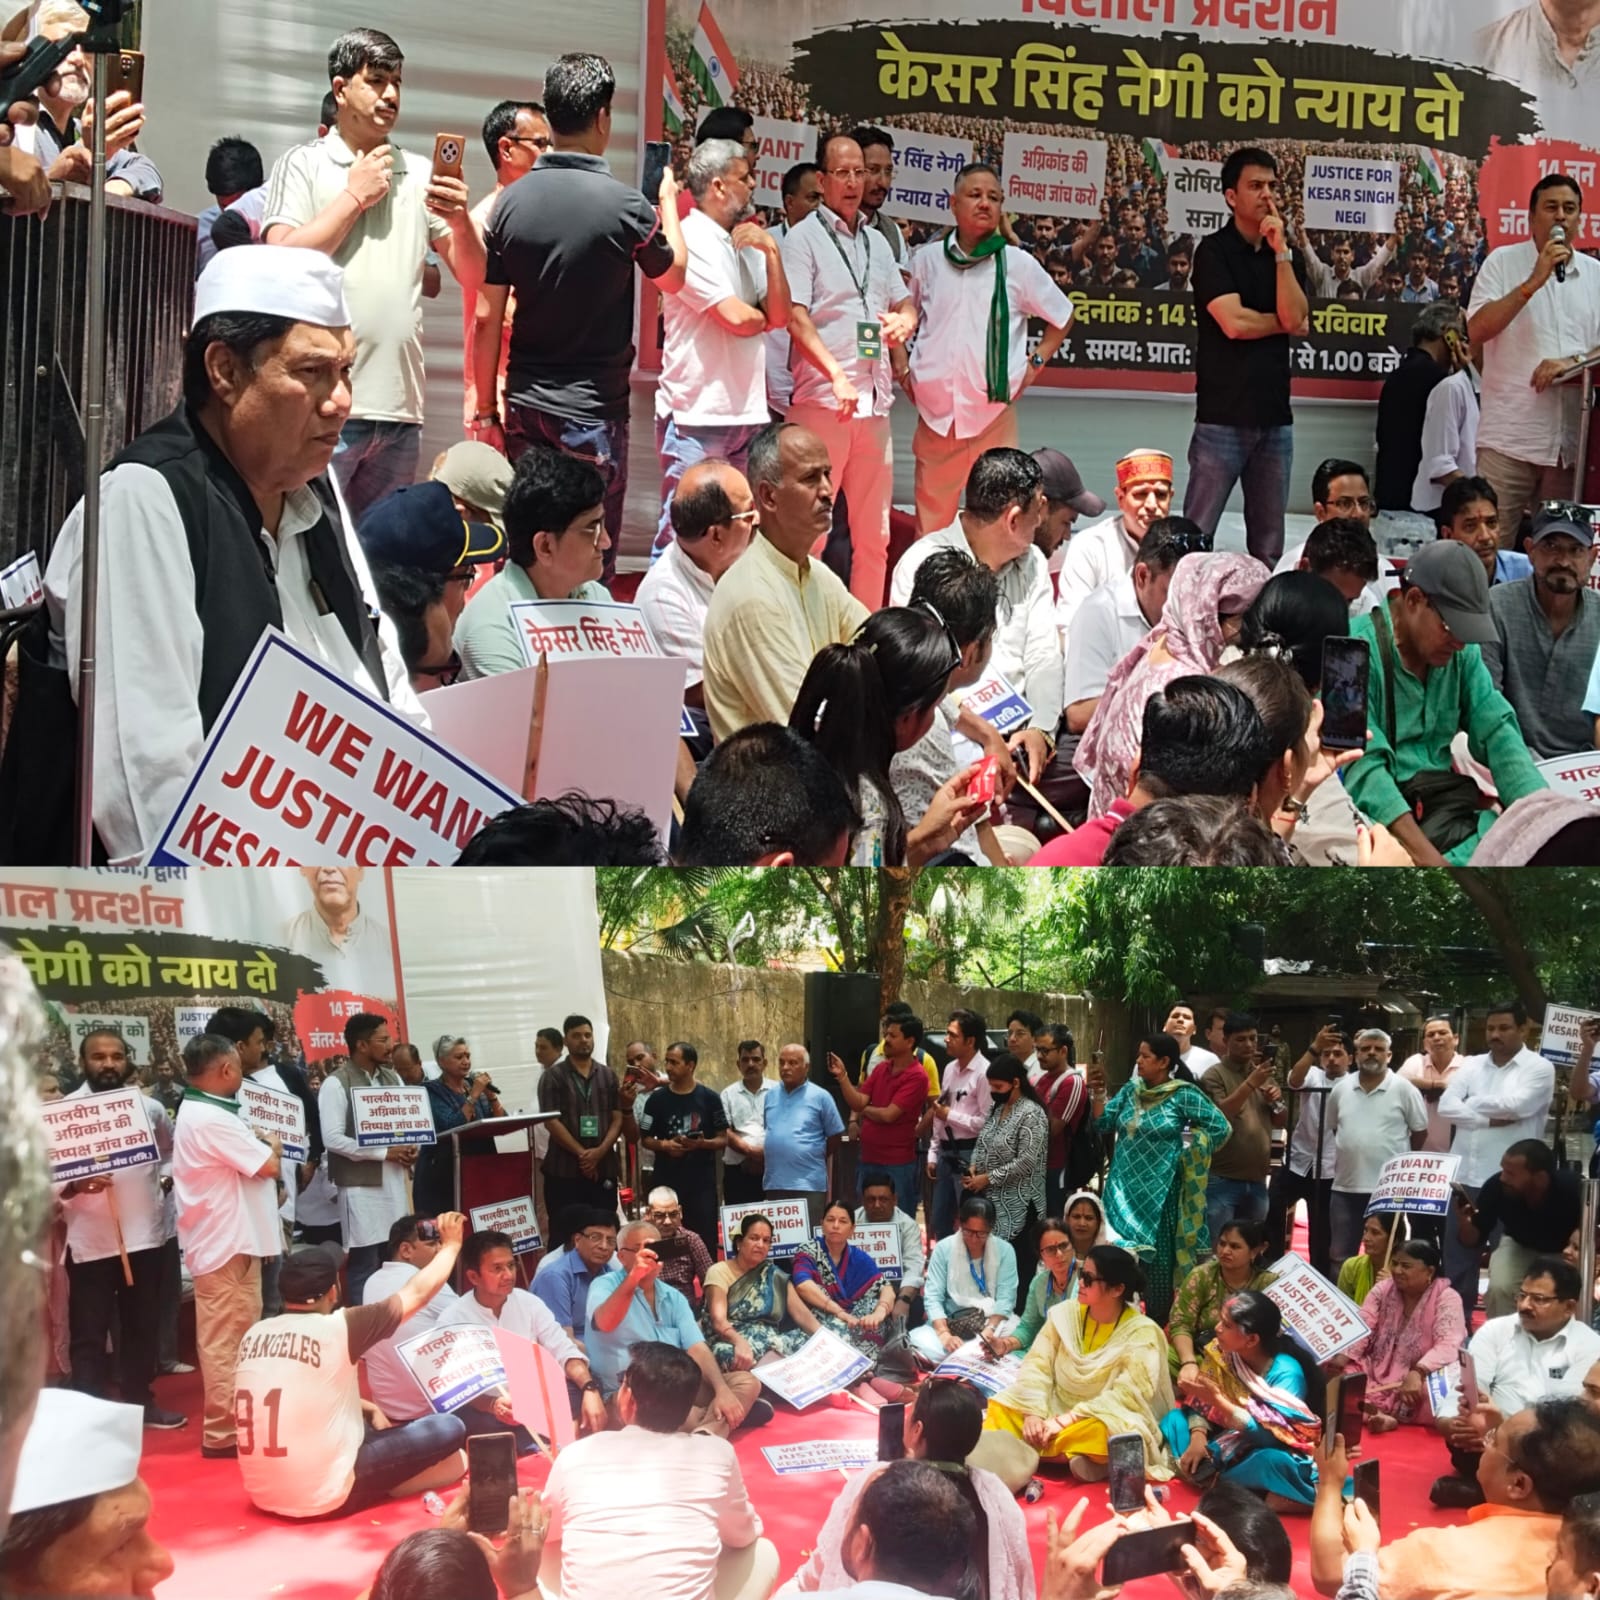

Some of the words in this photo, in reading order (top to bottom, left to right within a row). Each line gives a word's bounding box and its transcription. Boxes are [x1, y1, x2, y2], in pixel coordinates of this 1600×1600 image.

[876, 31, 1003, 106] केसर
[1010, 42, 1109, 121] सिंह
[1116, 49, 1209, 119] नेगी
[1216, 58, 1286, 124] को
[1293, 78, 1406, 133] न्याय
[1413, 72, 1465, 141] दो
[904, 146, 934, 172] सिंह
[936, 150, 966, 173] नेगी
[1070, 149, 1088, 174] की
[1311, 164, 1364, 182] JUSTICE
[1366, 168, 1393, 183] FOR
[896, 187, 933, 207] न्याय
[935, 188, 951, 211] दो
[1009, 176, 1047, 201] निष्पक्ष
[1049, 180, 1073, 204] जांच
[1074, 182, 1098, 208] करो
[1307, 186, 1351, 201] KESAR
[1353, 189, 1396, 205] SINGH
[1186, 208, 1224, 230] सजा
[1335, 210, 1367, 225] NEGI
[1067, 291, 1142, 325] दिनांक
[1158, 303, 1186, 327] 14
[1312, 303, 1388, 336] रविवार
[1296, 341, 1317, 370] से
[1319, 349, 1364, 372] 1.00
[1367, 344, 1402, 374] बजे
[523, 618, 583, 654] केसर
[579, 615, 622, 656] सिंह
[614, 618, 653, 654] नेगी
[973, 679, 1006, 703] करो
[283, 690, 373, 779] WE
[372, 747, 497, 851] WAN
[220, 744, 417, 866] JUSTICE
[64, 884, 185, 929] प्रदर्शन
[99, 943, 152, 987] को
[157, 956, 238, 990] न्याय
[243, 950, 278, 994] दो
[329, 1001, 344, 1017] 14
[126, 1021, 145, 1037] को
[1548, 1024, 1579, 1038] KESAR
[104, 1098, 135, 1113] नगर
[243, 1088, 279, 1108] मालवीय
[281, 1100, 300, 1114] नगर
[361, 1091, 400, 1104] मालवीय
[403, 1094, 422, 1103] नगर
[408, 1104, 420, 1115] की
[114, 1114, 132, 1129] की
[285, 1114, 297, 1128] की
[414, 1118, 431, 1129] करो
[93, 1137, 122, 1153] जांच
[124, 1129, 149, 1147] करो
[1400, 1158, 1445, 1170] WANT
[1418, 1173, 1448, 1184] FOR
[1391, 1186, 1421, 1198] SINGH
[1421, 1188, 1447, 1199] NEGI
[511, 1204, 528, 1215] नगर
[777, 1205, 800, 1218] FOR
[517, 1214, 527, 1225] की
[868, 1230, 891, 1240] नगर
[873, 1241, 887, 1252] की
[879, 1255, 897, 1266] करो
[1297, 1274, 1319, 1293] WE
[1314, 1290, 1353, 1328] WANT
[1279, 1281, 1321, 1318] JUSTICE
[1316, 1316, 1343, 1345] FOR
[1284, 1308, 1312, 1335] SINGH
[1306, 1331, 1331, 1356] NEGI
[248, 1332, 321, 1369] ANGELES
[778, 1448, 839, 1461] JUSTICE
